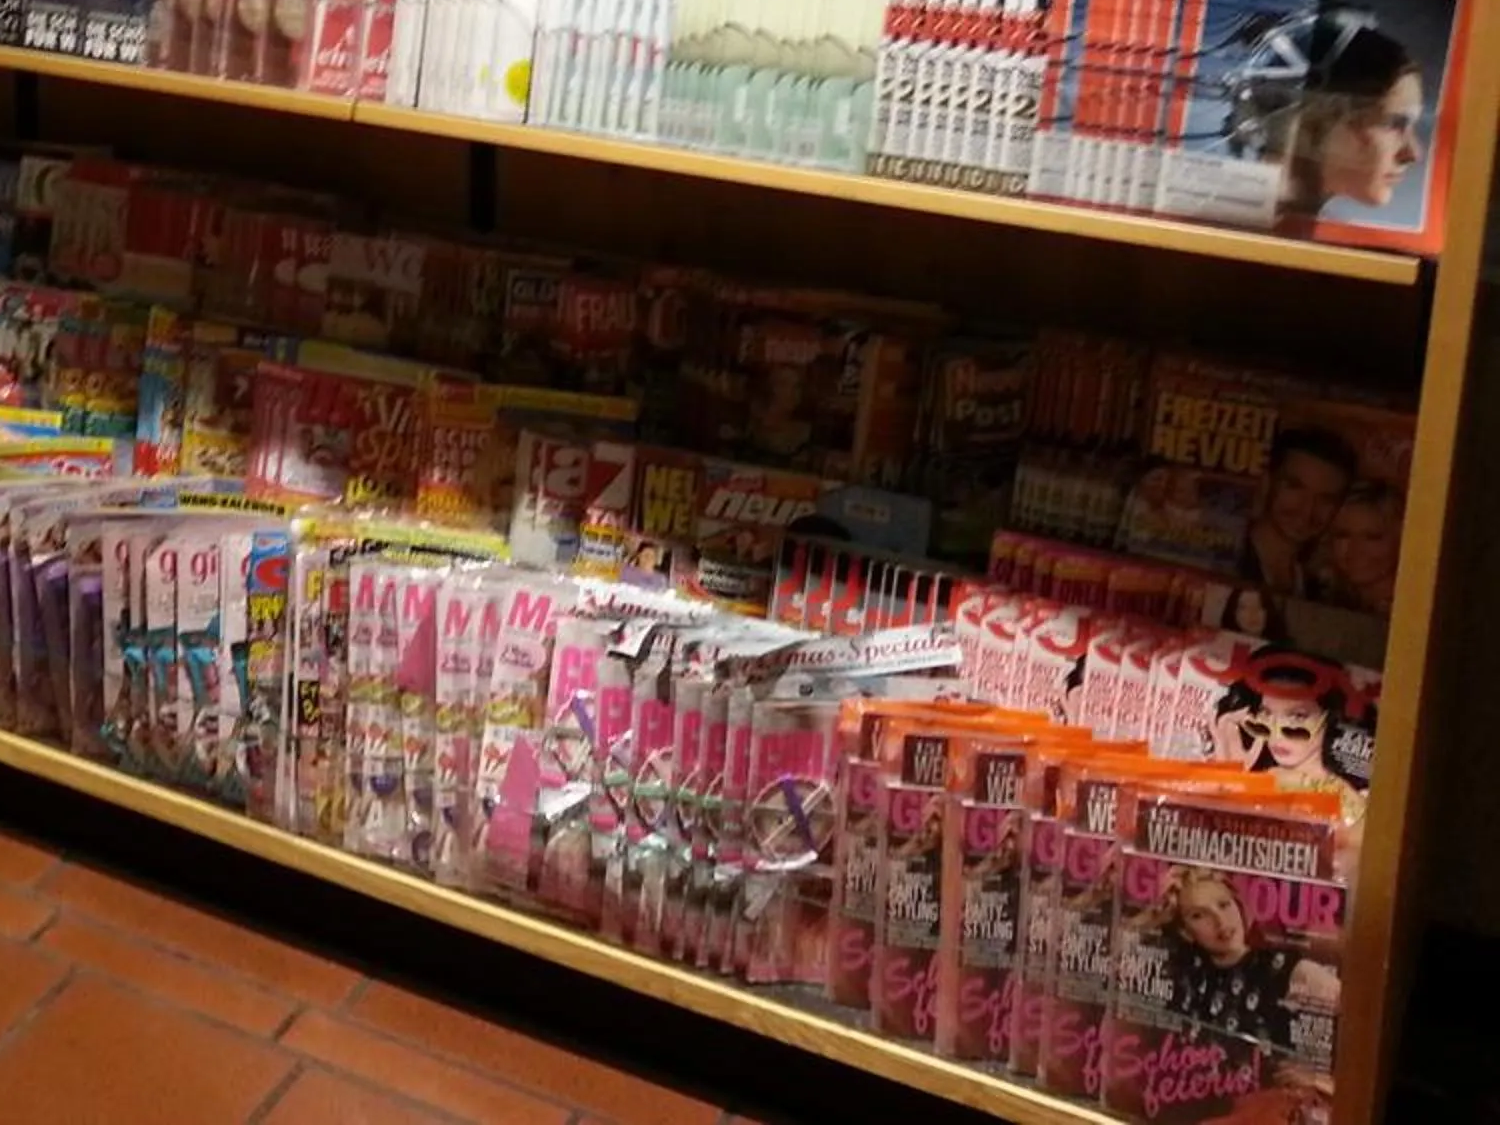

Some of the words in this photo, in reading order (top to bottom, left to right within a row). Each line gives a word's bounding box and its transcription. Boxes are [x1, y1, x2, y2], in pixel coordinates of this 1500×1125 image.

[956, 398, 1023, 428] Post
[1155, 390, 1279, 440] FREIZEIT
[1151, 424, 1271, 475] REVUE
[1147, 820, 1320, 878] WEIHNACHTSIDEEN
[1125, 856, 1342, 932] GOUR
[963, 919, 1014, 941] STYLING
[1118, 973, 1174, 1002] STYLING
